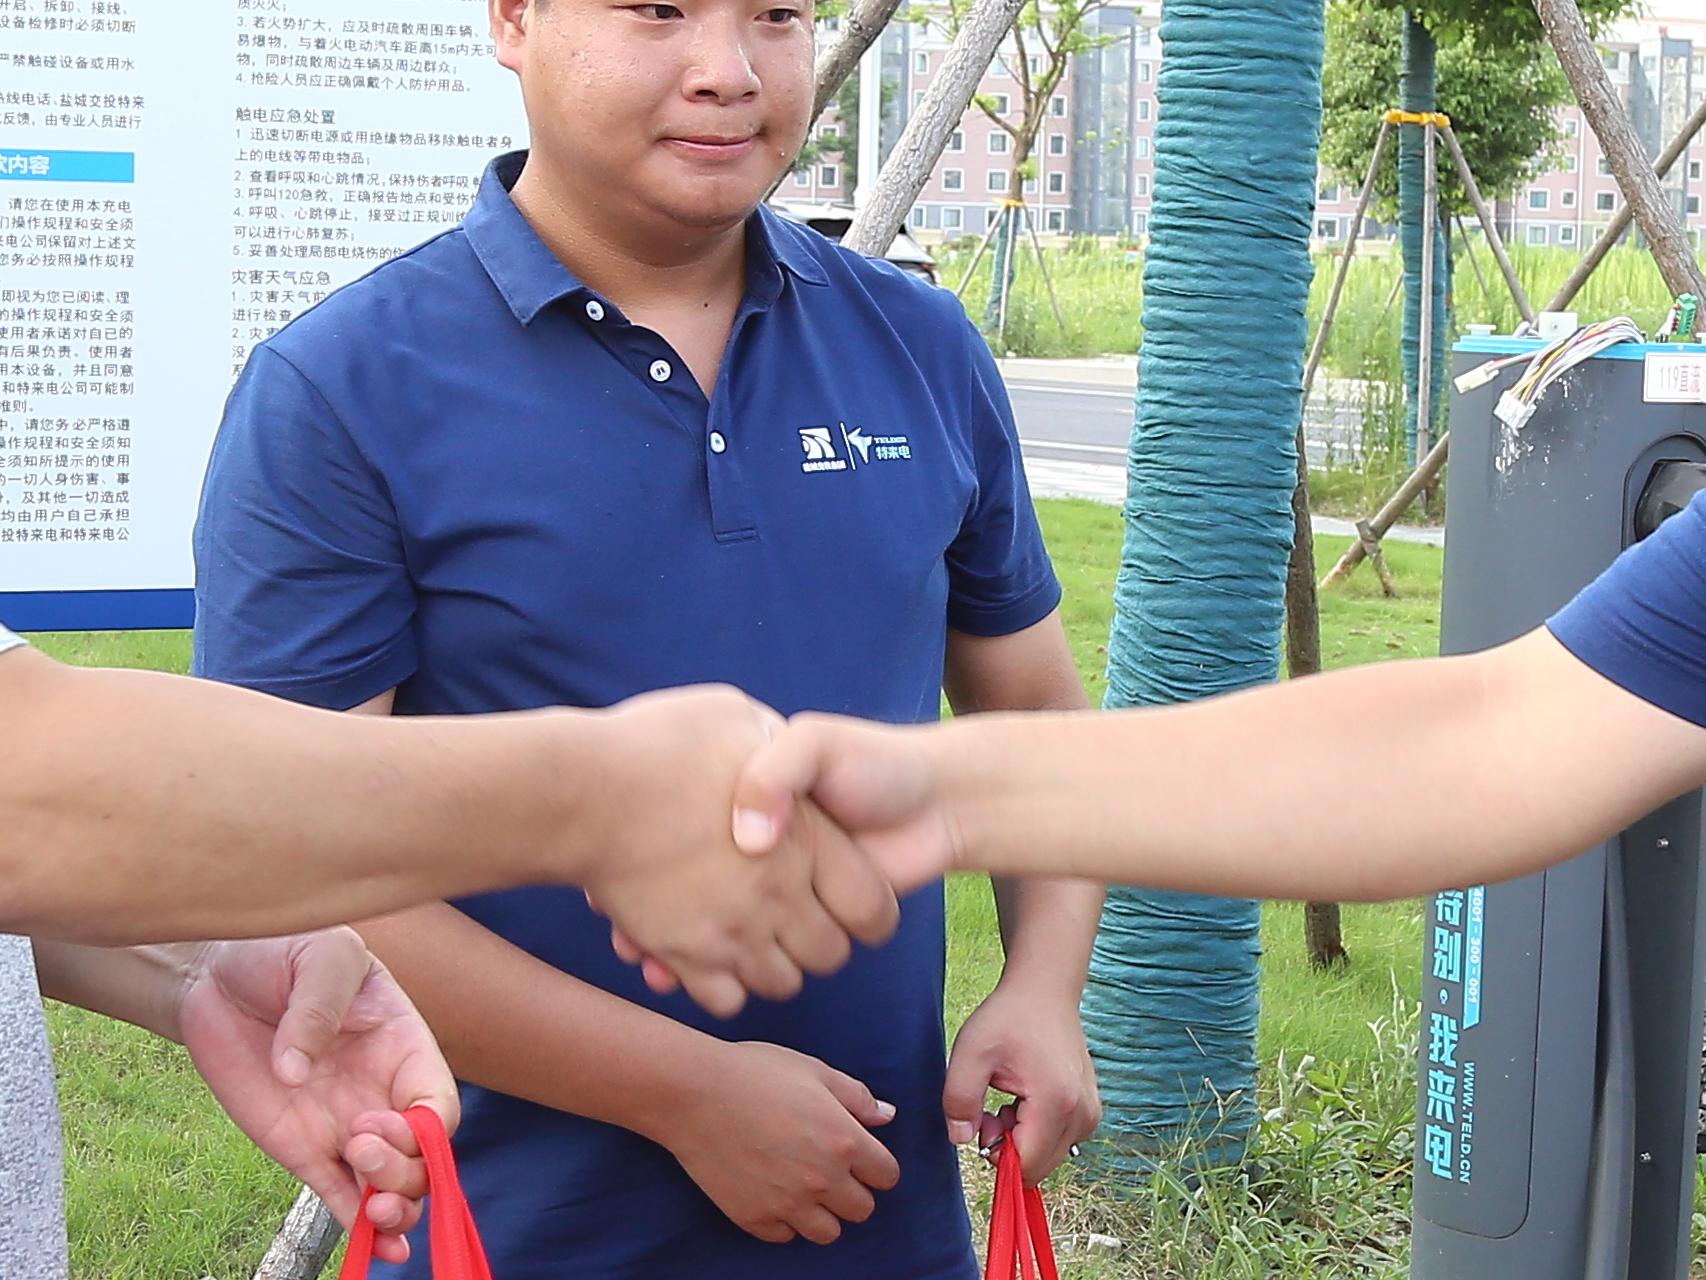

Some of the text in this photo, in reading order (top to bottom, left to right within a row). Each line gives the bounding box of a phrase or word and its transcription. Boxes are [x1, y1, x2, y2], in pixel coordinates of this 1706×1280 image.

[235, 107, 336, 125] 触电应急处置
[231, 269, 332, 286] 灾害天气应急
[875, 446, 912, 460] 特来电
[1459, 1062, 1476, 1185] WWW.TELD.CN
